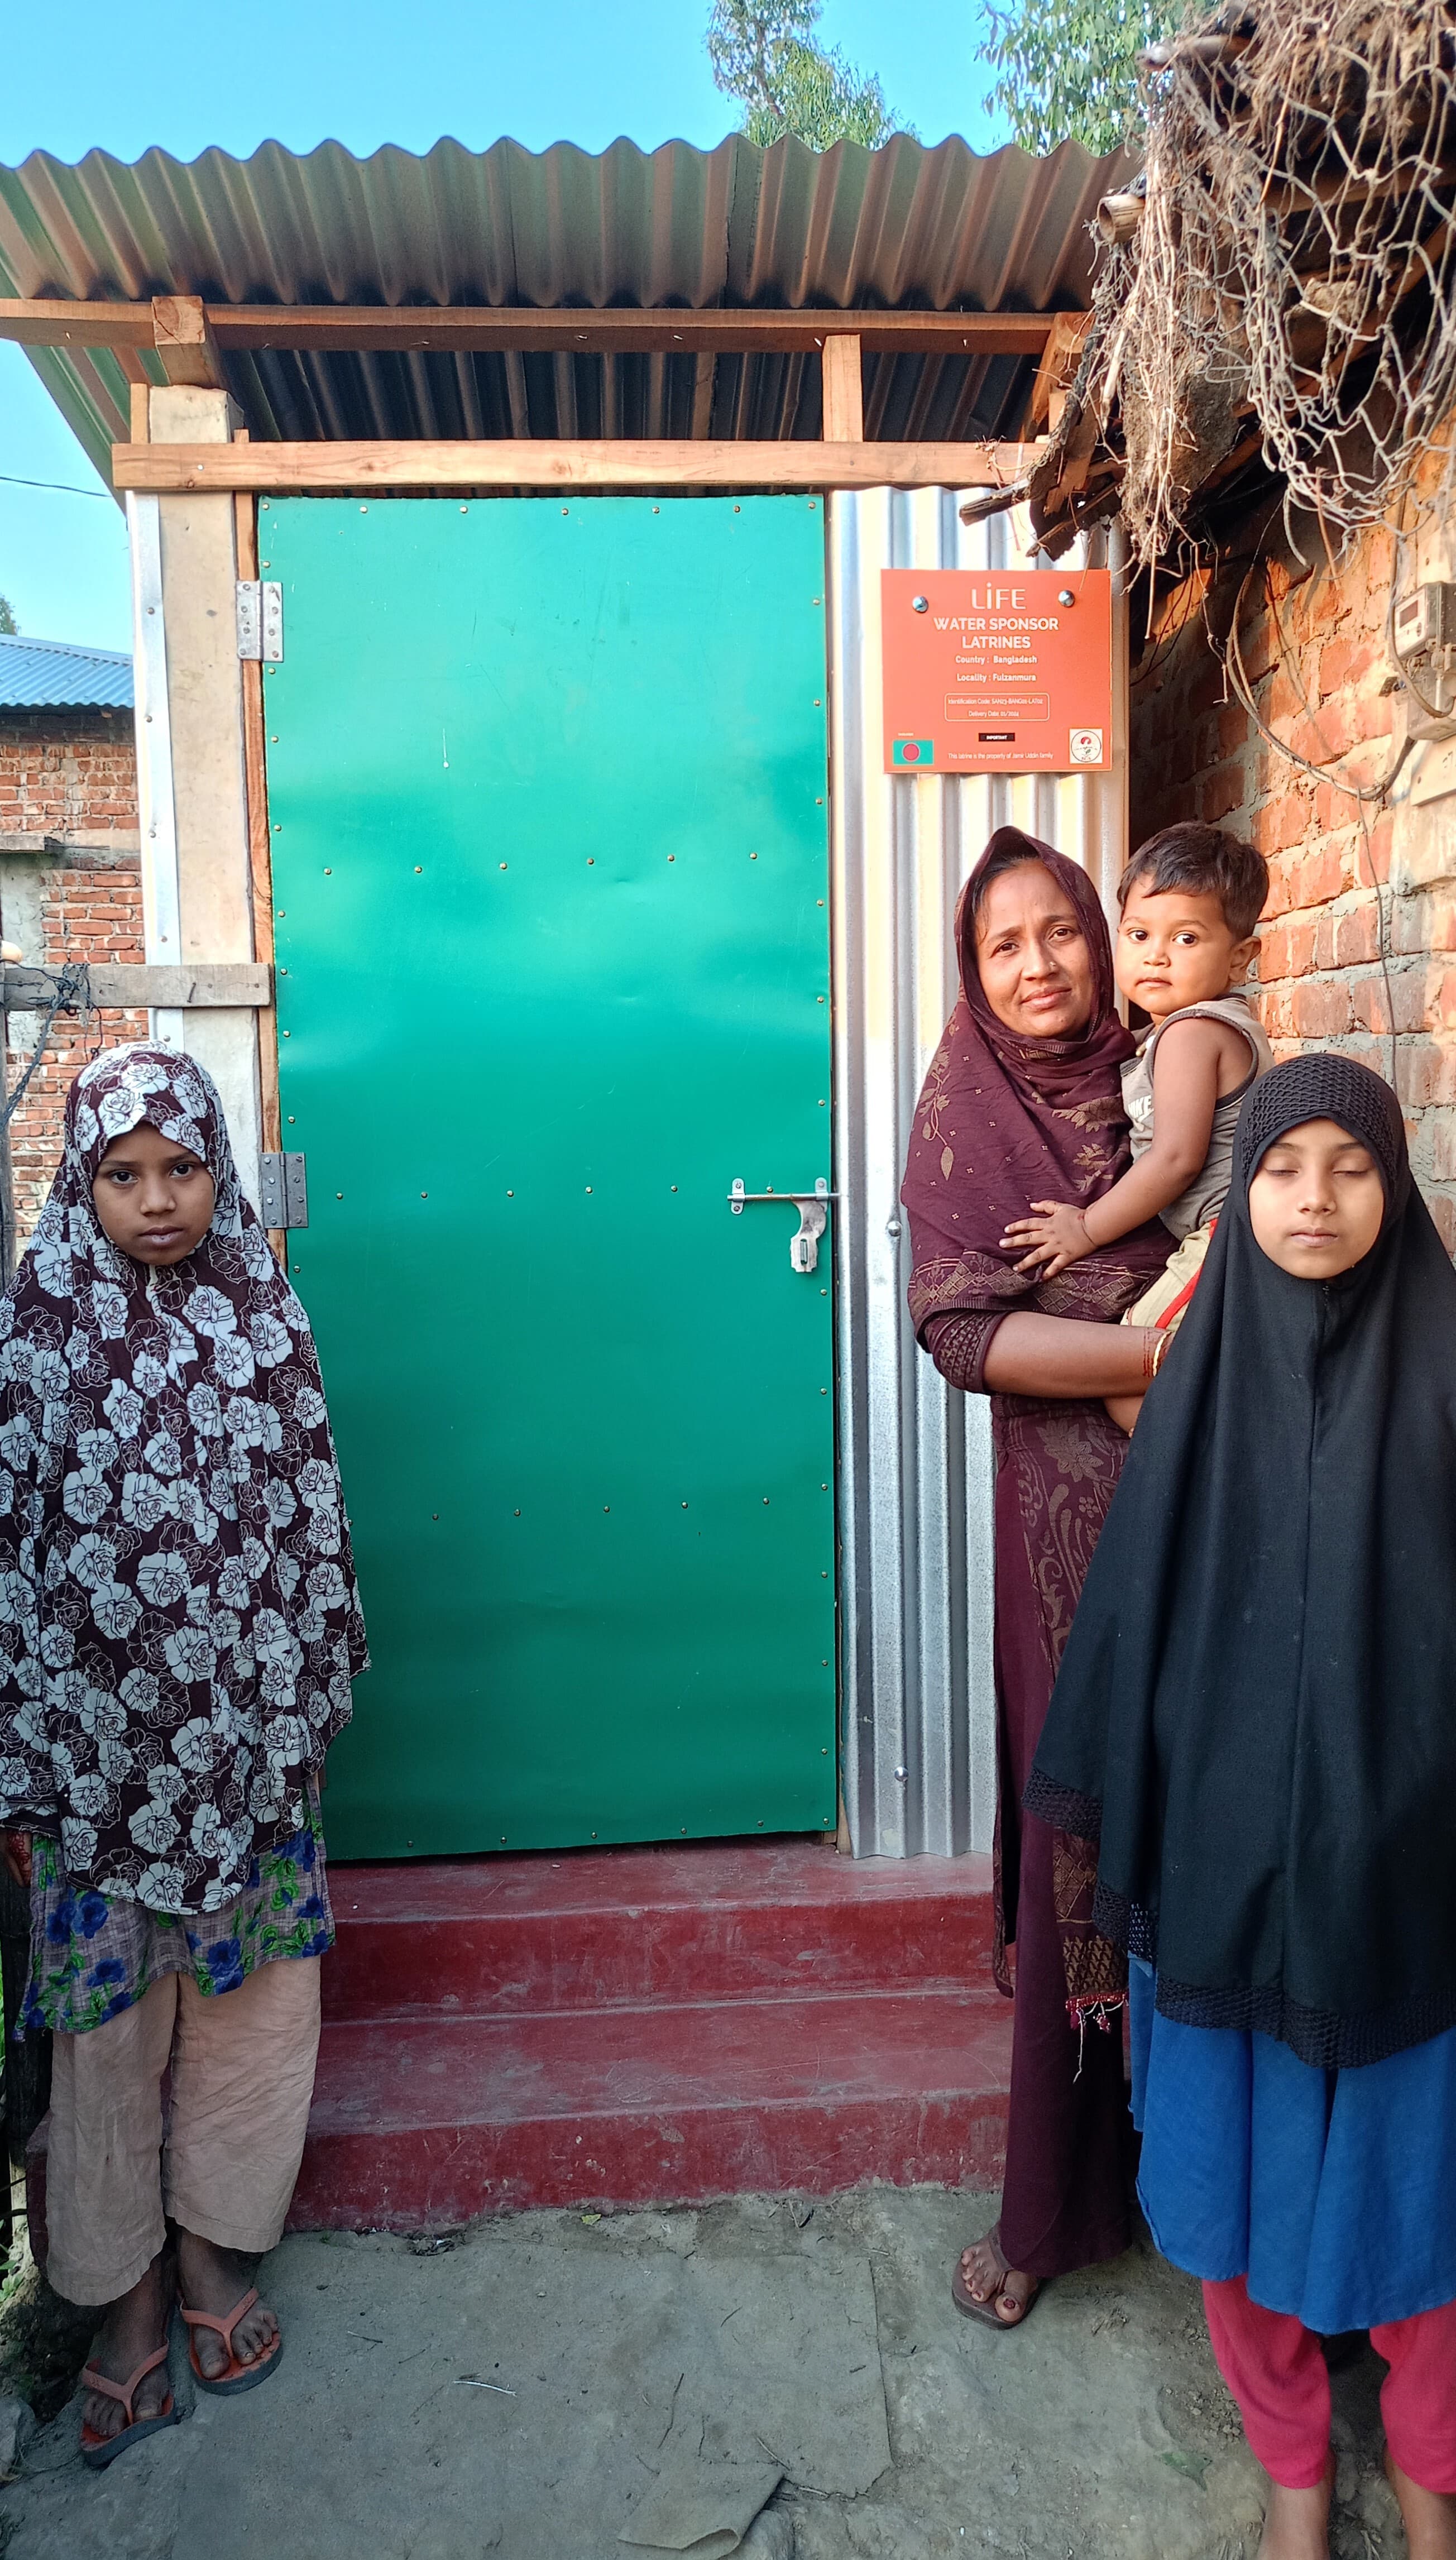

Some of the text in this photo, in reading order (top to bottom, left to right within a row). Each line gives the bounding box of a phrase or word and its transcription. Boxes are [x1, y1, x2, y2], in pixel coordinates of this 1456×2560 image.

[933, 617, 1059, 630] WATER SPONSOR
[962, 635, 1031, 649] LATRINES
[955, 655, 985, 665] Country
[993, 655, 1037, 665] Bangladesh
[956, 673, 987, 683] Locality
[993, 673, 1036, 682] Fulzanmura
[1128, 1095, 1154, 1123] NIKE
